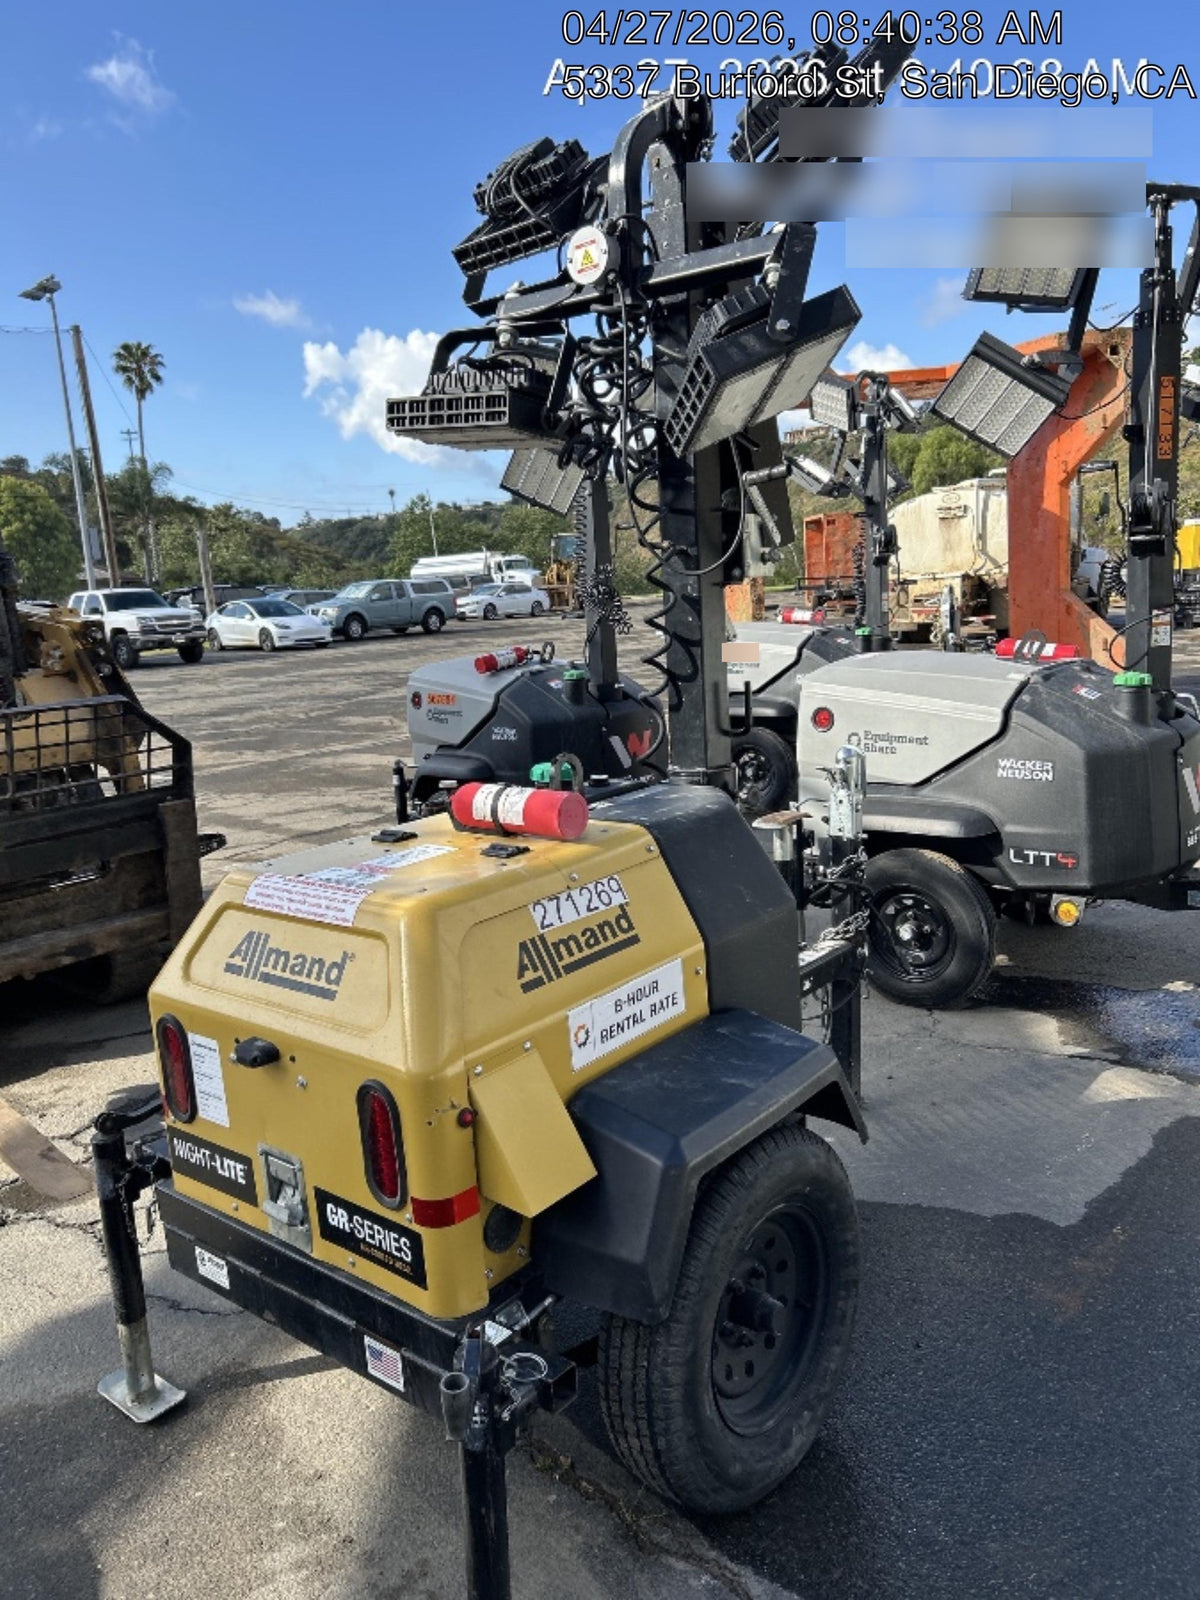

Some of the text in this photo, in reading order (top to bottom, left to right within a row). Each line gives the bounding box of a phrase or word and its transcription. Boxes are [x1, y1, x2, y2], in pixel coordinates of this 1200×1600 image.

[863, 730, 930, 747] Equipment
[997, 758, 1053, 771] WACKER
[996, 768, 1054, 782] NEUSON
[1009, 848, 1077, 869] LTT4
[532, 876, 627, 931] 271269
[226, 930, 352, 992] Allmand
[517, 902, 637, 986] Allmand
[600, 991, 679, 1045] RENTAL RATE
[326, 1202, 412, 1262] GR-SERIES
